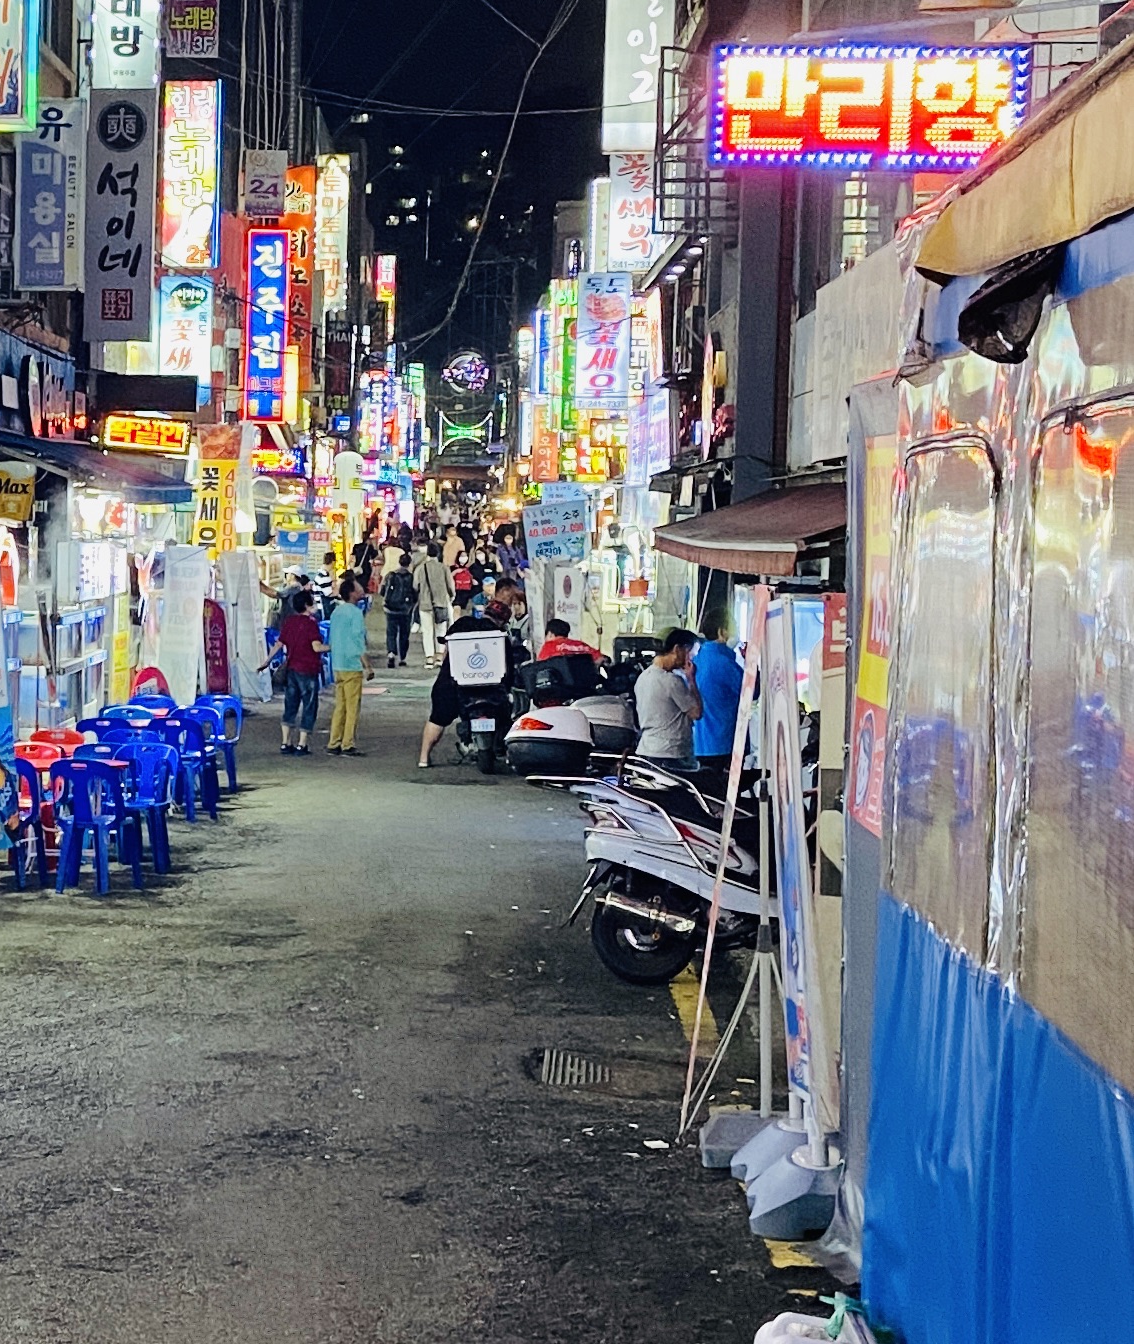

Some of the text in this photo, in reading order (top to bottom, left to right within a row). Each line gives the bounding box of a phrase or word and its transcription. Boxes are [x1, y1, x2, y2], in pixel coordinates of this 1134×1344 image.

[170, 6, 215, 31] 노래방
[191, 36, 216, 53] 3F
[36, 106, 73, 143] 유
[169, 85, 216, 119] 힐링
[727, 56, 1014, 155] 만리향
[169, 119, 214, 208] 노래방
[249, 178, 280, 198] 24
[27, 152, 63, 265] 미용실
[66, 155, 78, 250] BEAUTY SALON
[96, 162, 143, 279] 석이네
[186, 244, 210, 264] 2F
[252, 239, 285, 369] 진주집
[583, 321, 620, 398] 꽃새우
[561, 509, 580, 521] 소주
